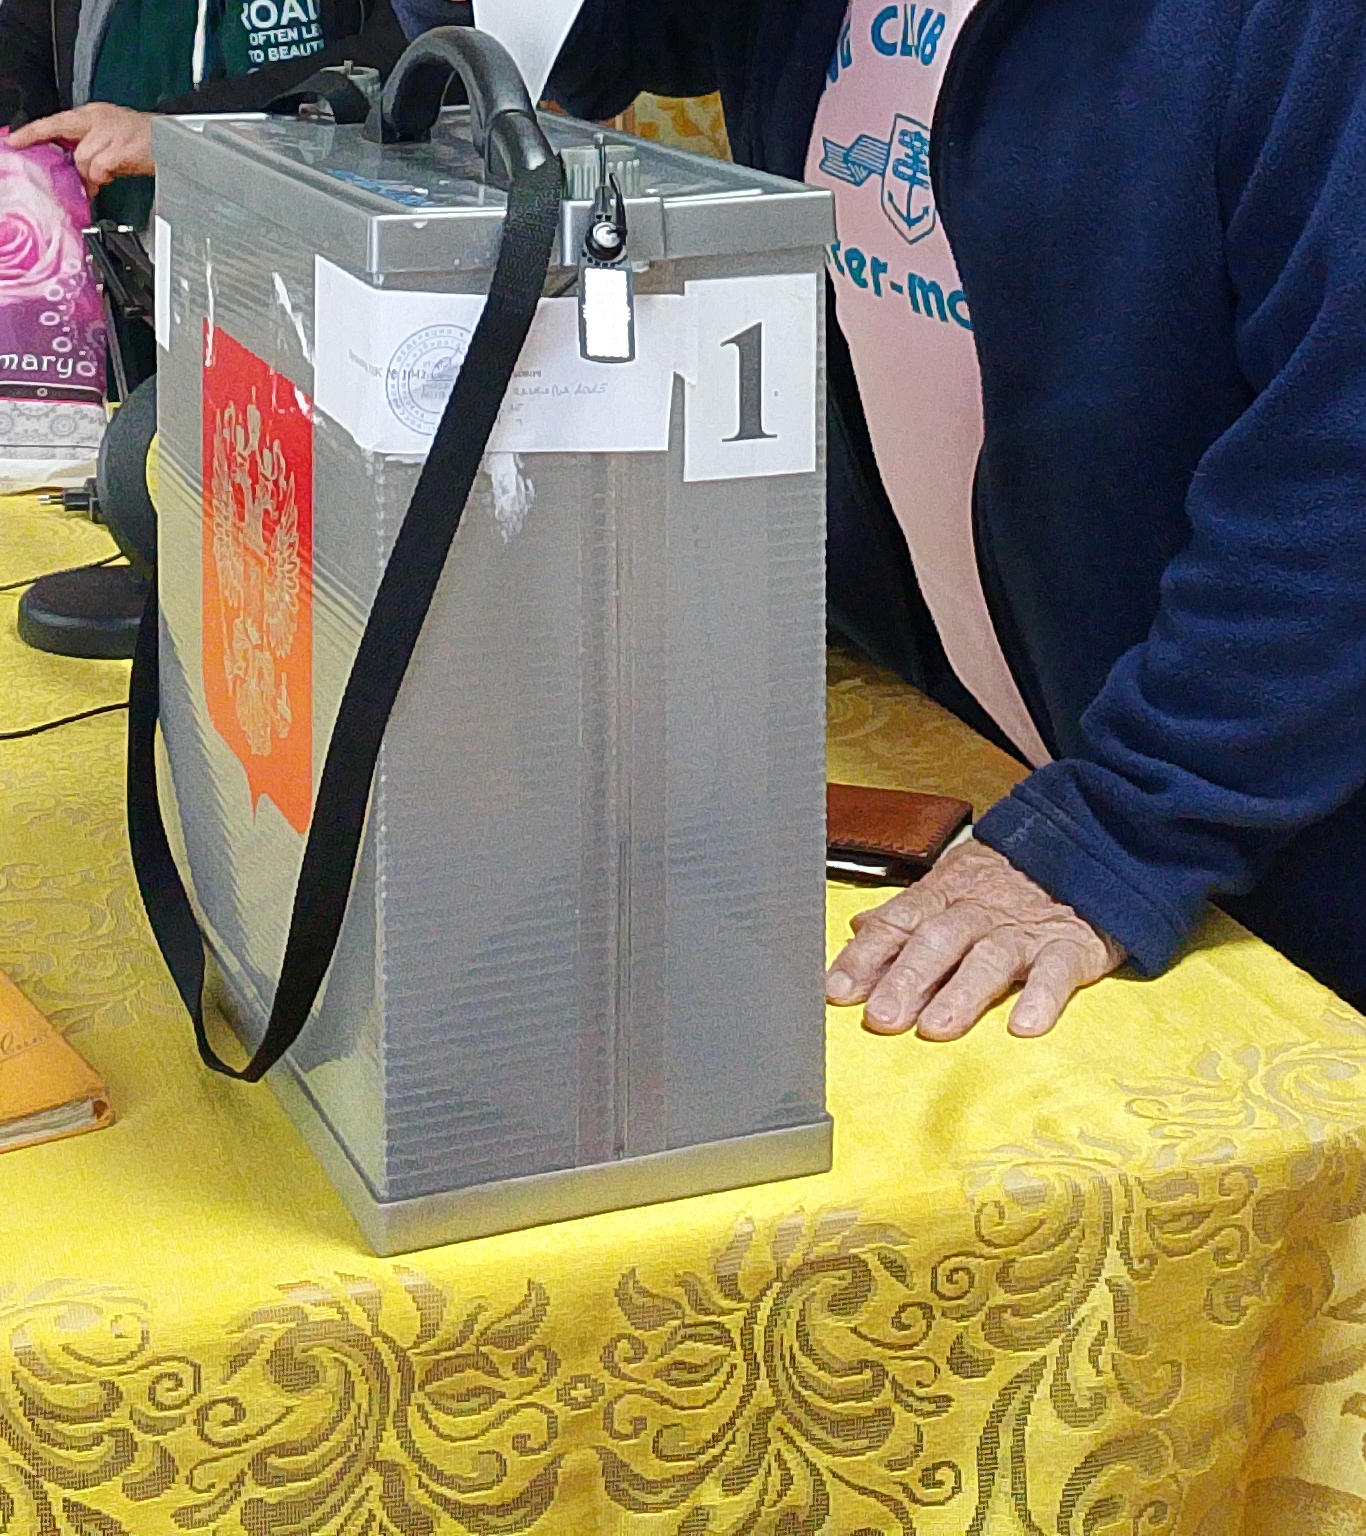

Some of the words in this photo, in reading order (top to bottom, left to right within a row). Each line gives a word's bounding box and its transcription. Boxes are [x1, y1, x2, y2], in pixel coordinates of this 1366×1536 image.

[249, 27, 298, 46] OFTEN
[301, 24, 323, 39] LE
[248, 49, 264, 63] TO
[719, 321, 778, 443] 1
